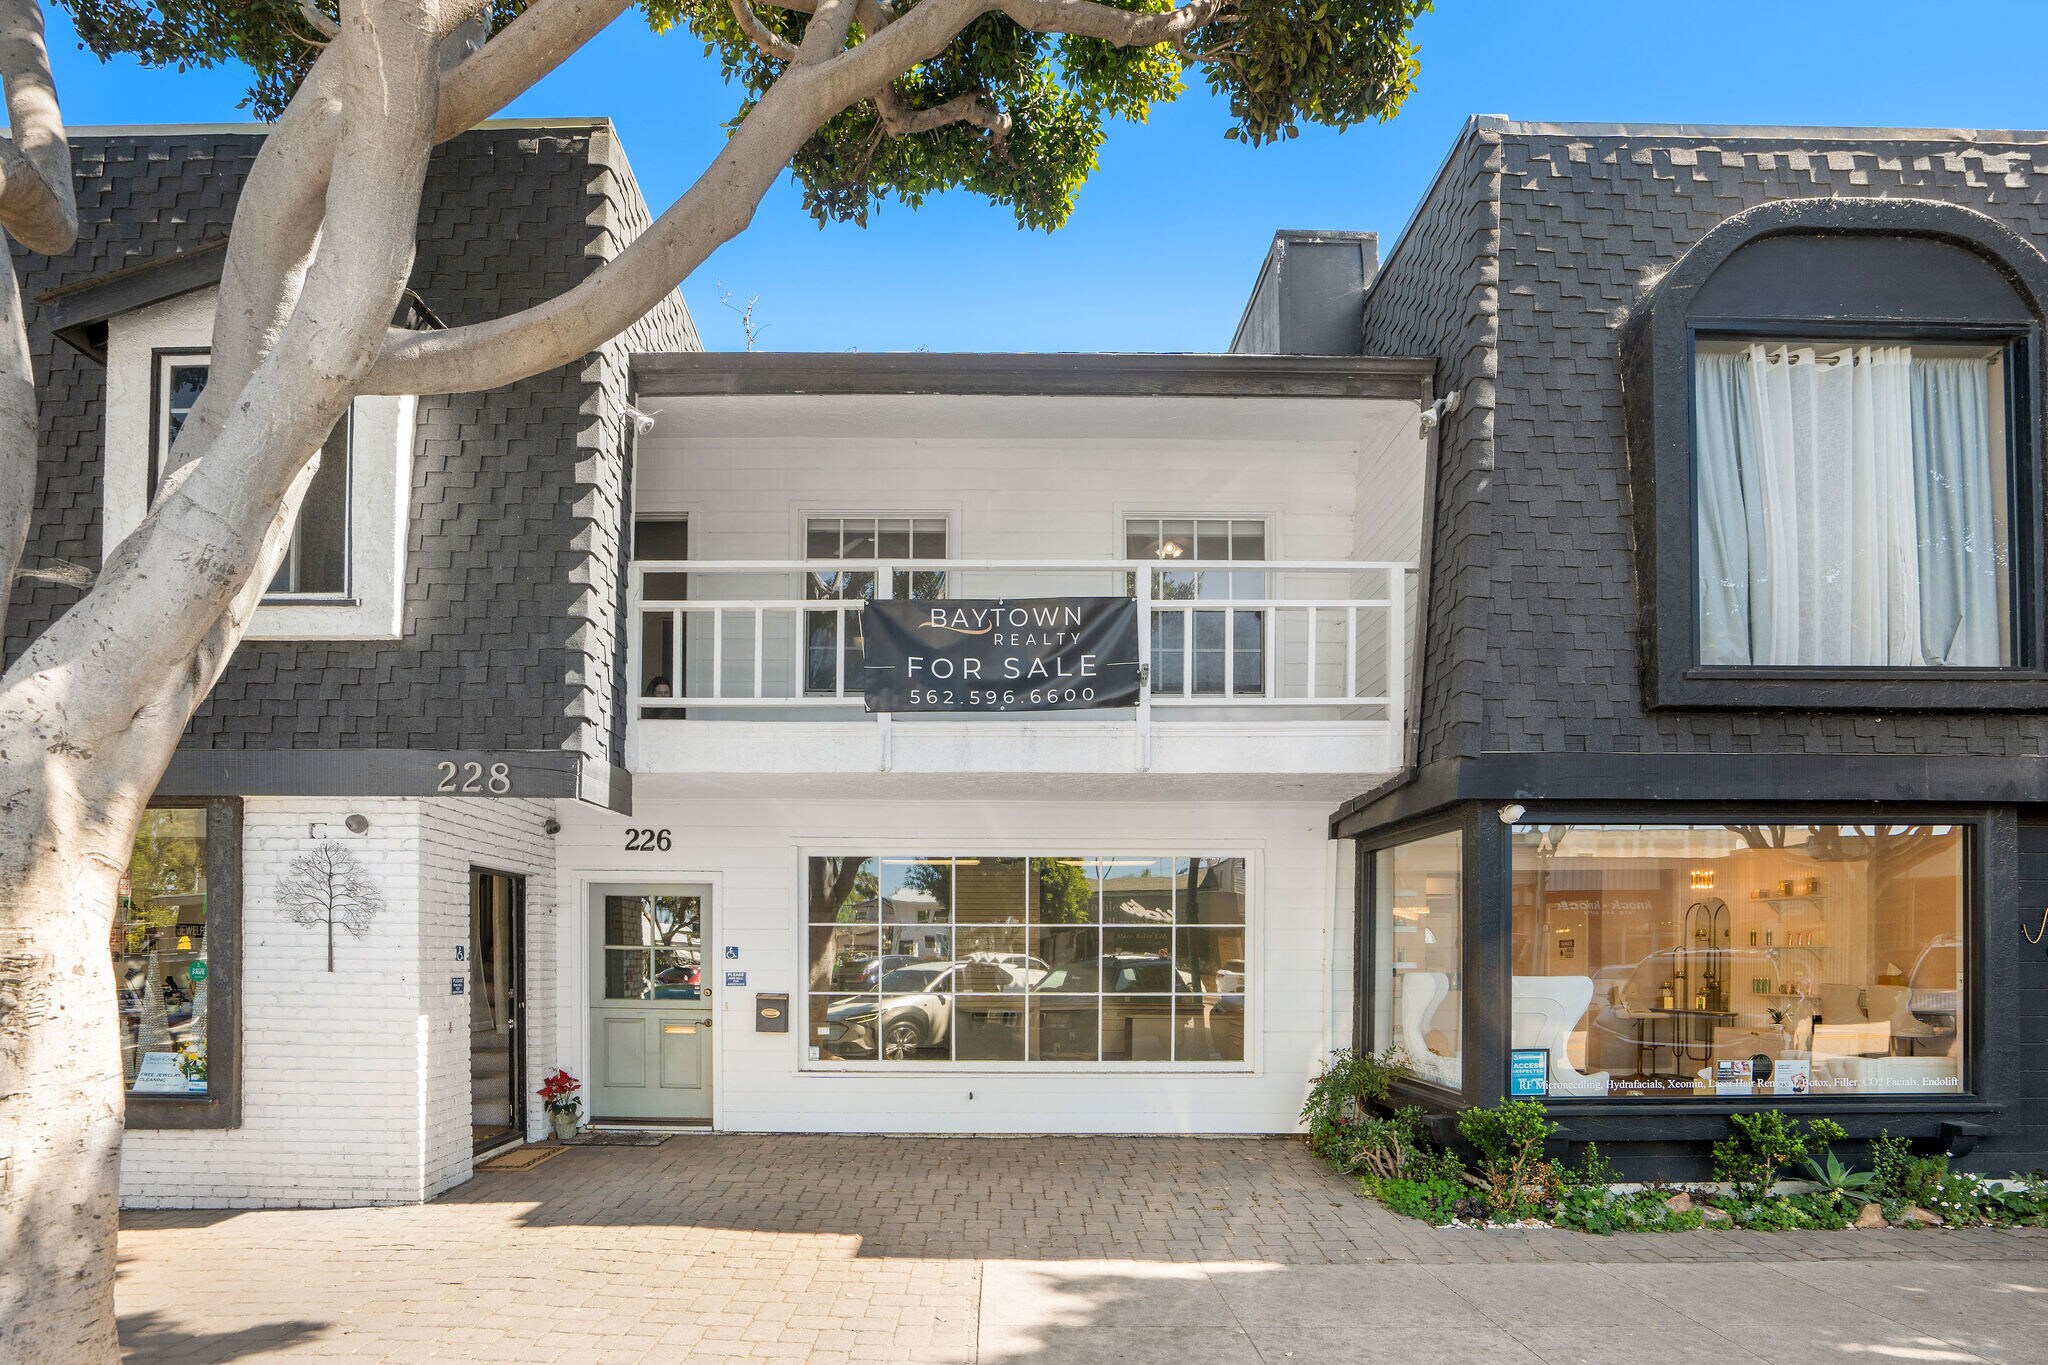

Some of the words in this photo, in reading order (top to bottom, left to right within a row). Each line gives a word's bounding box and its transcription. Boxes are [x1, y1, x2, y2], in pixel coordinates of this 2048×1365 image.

[930, 606, 1081, 628] BAYTOWN
[994, 632, 1080, 646] REALTY
[907, 656, 982, 680] FOR
[1004, 655, 1097, 679] SALE
[909, 687, 1095, 705] 562.596.6600
[436, 761, 511, 794] 228
[624, 828, 672, 852] 226
[1519, 1081, 1533, 1090] RF
[1535, 1080, 1604, 1092] Microneedling,
[1606, 1079, 1665, 1091] Hydrafacials,
[1667, 1079, 1706, 1089] Xeomin,
[1709, 1079, 1735, 1088] Laser
[1735, 1078, 1755, 1088] Hair
[1802, 1078, 1832, 1088] Botox,
[1834, 1077, 1861, 1087] Filler,
[1863, 1077, 1883, 1087] CO2
[1886, 1077, 1920, 1087] Facials,
[1922, 1076, 1959, 1087] Endolift
